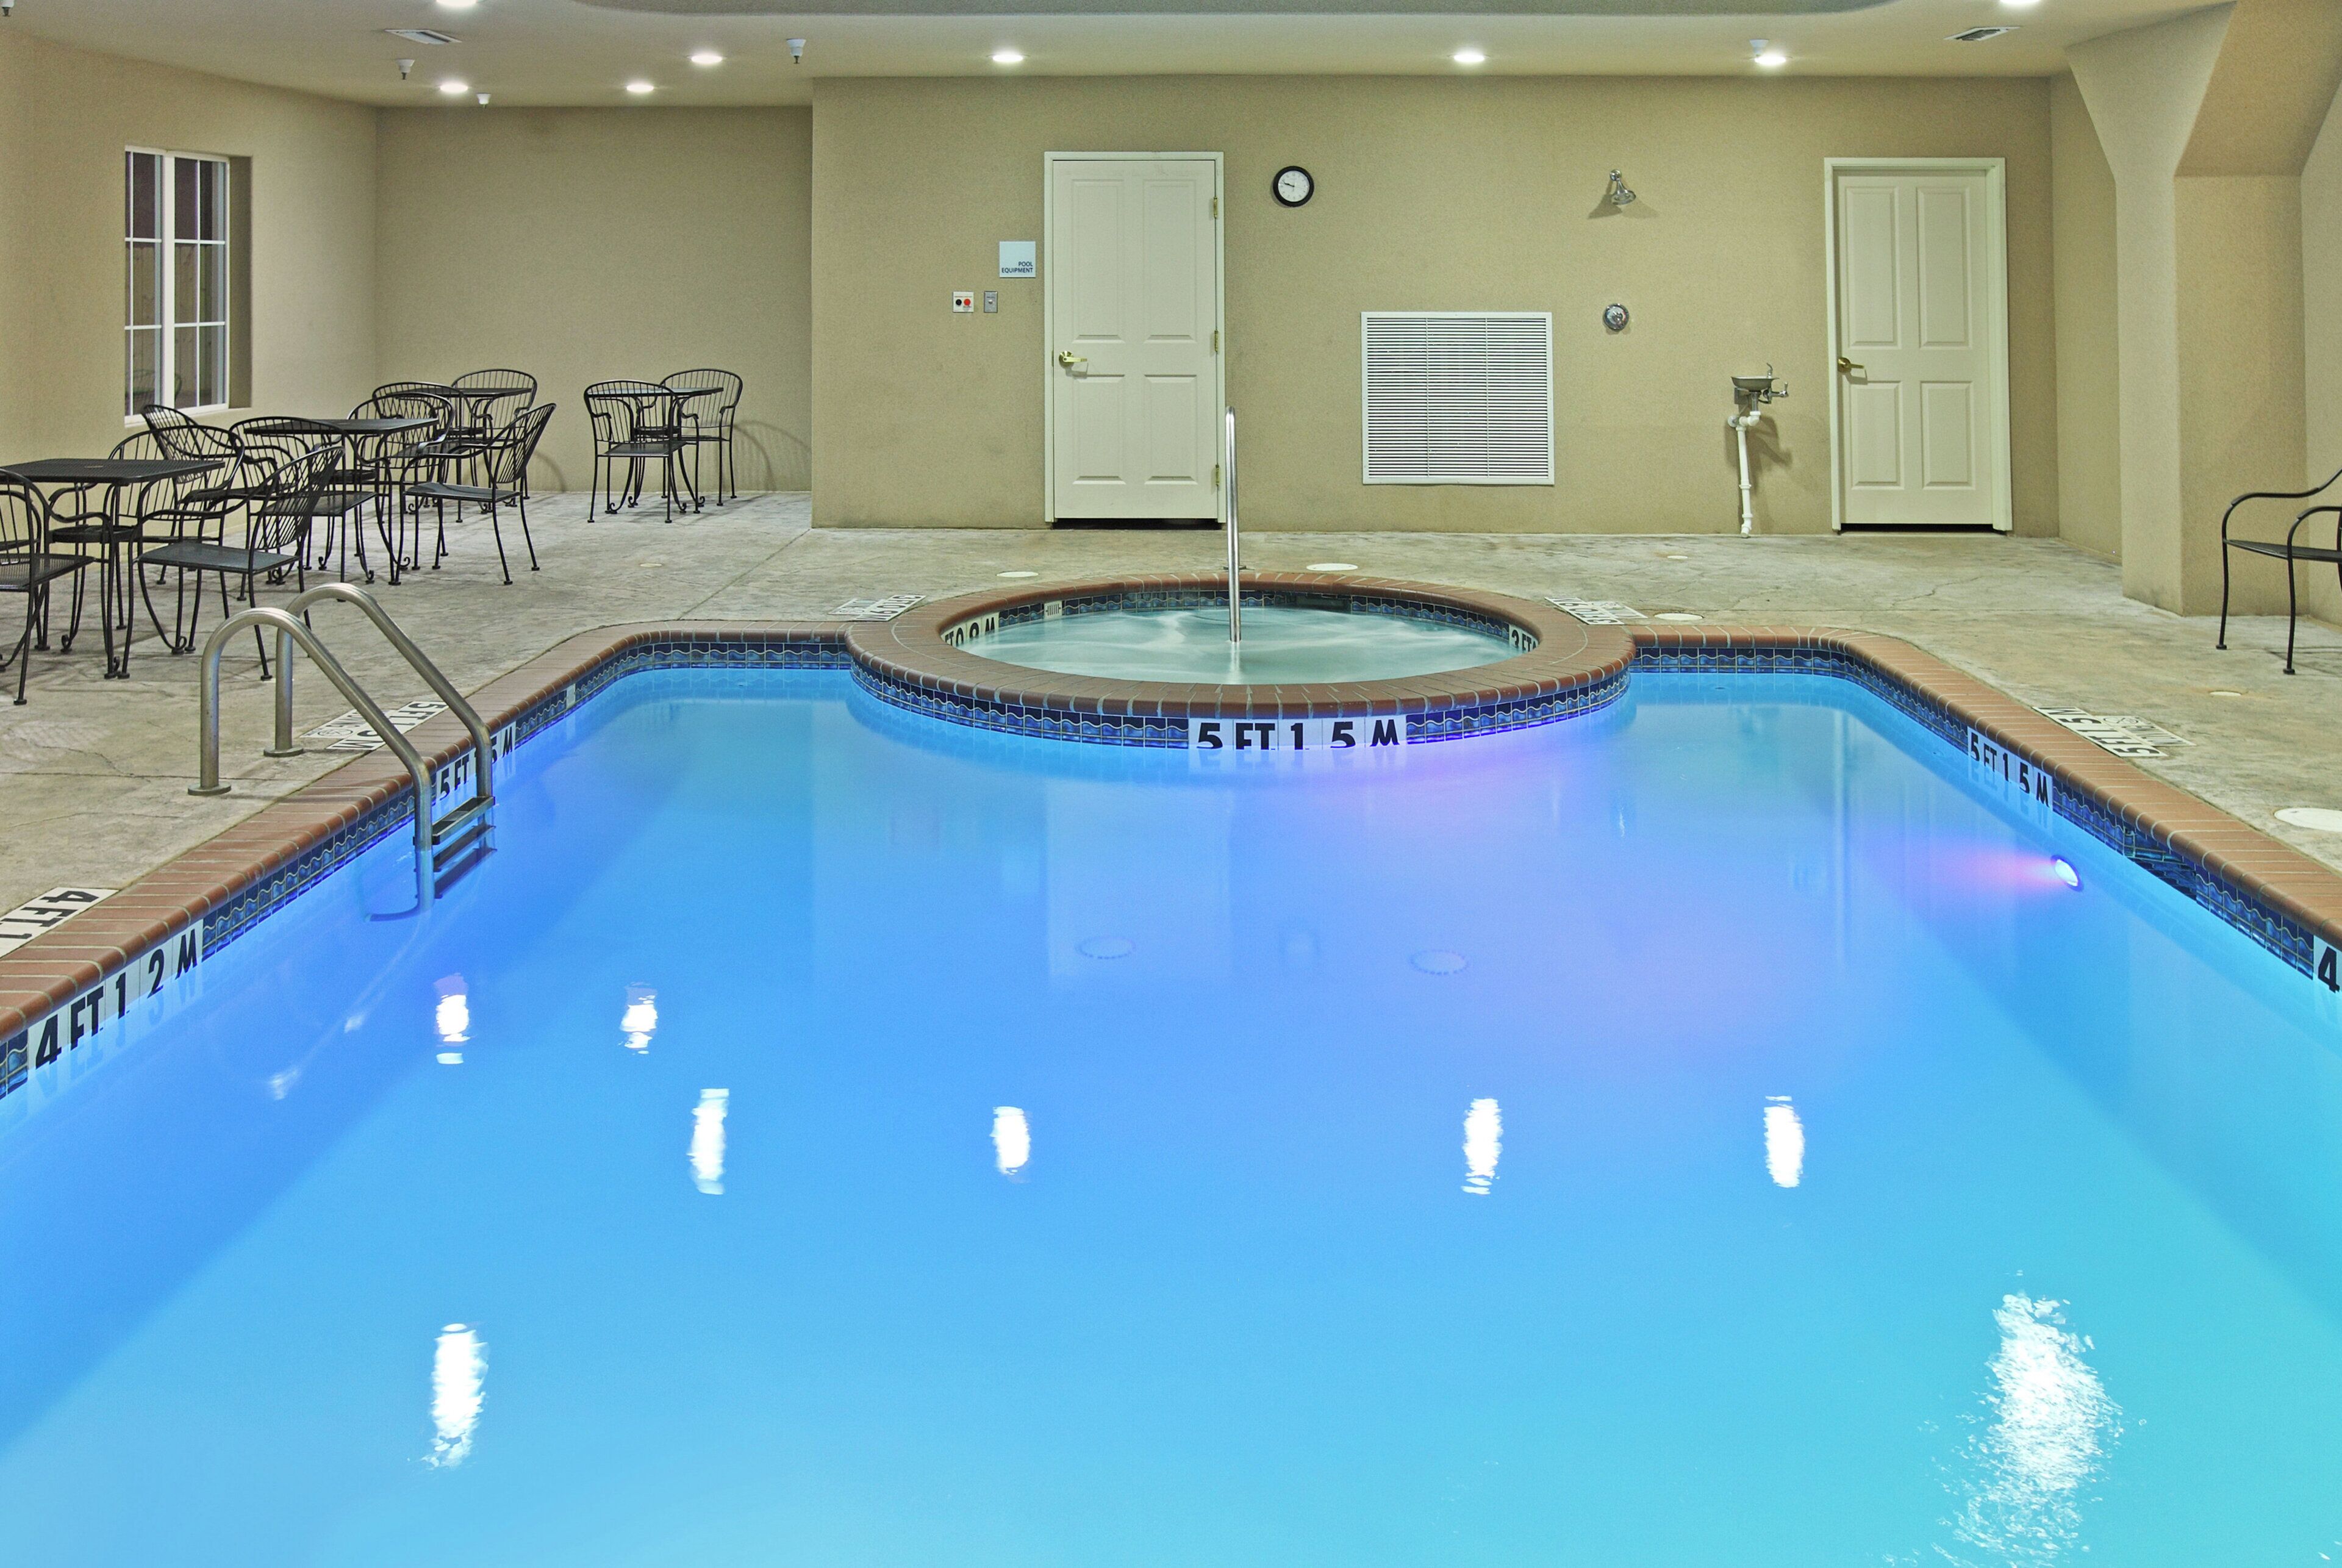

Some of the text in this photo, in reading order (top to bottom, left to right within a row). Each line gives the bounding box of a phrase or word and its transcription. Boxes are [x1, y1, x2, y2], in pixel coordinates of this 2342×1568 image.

[440, 767, 451, 801] 5
[502, 726, 513, 758] M
[1196, 722, 1223, 749] 5
[1330, 721, 1356, 748] 5
[1370, 719, 1401, 747] M
[1971, 732, 1980, 762] 5
[2019, 762, 2030, 794] 5
[2036, 772, 2050, 808] M
[39, 890, 100, 903] 4
[35, 1014, 62, 1070] 4
[147, 949, 165, 999] 2
[174, 928, 198, 981] M
[2318, 946, 2340, 993] 4
